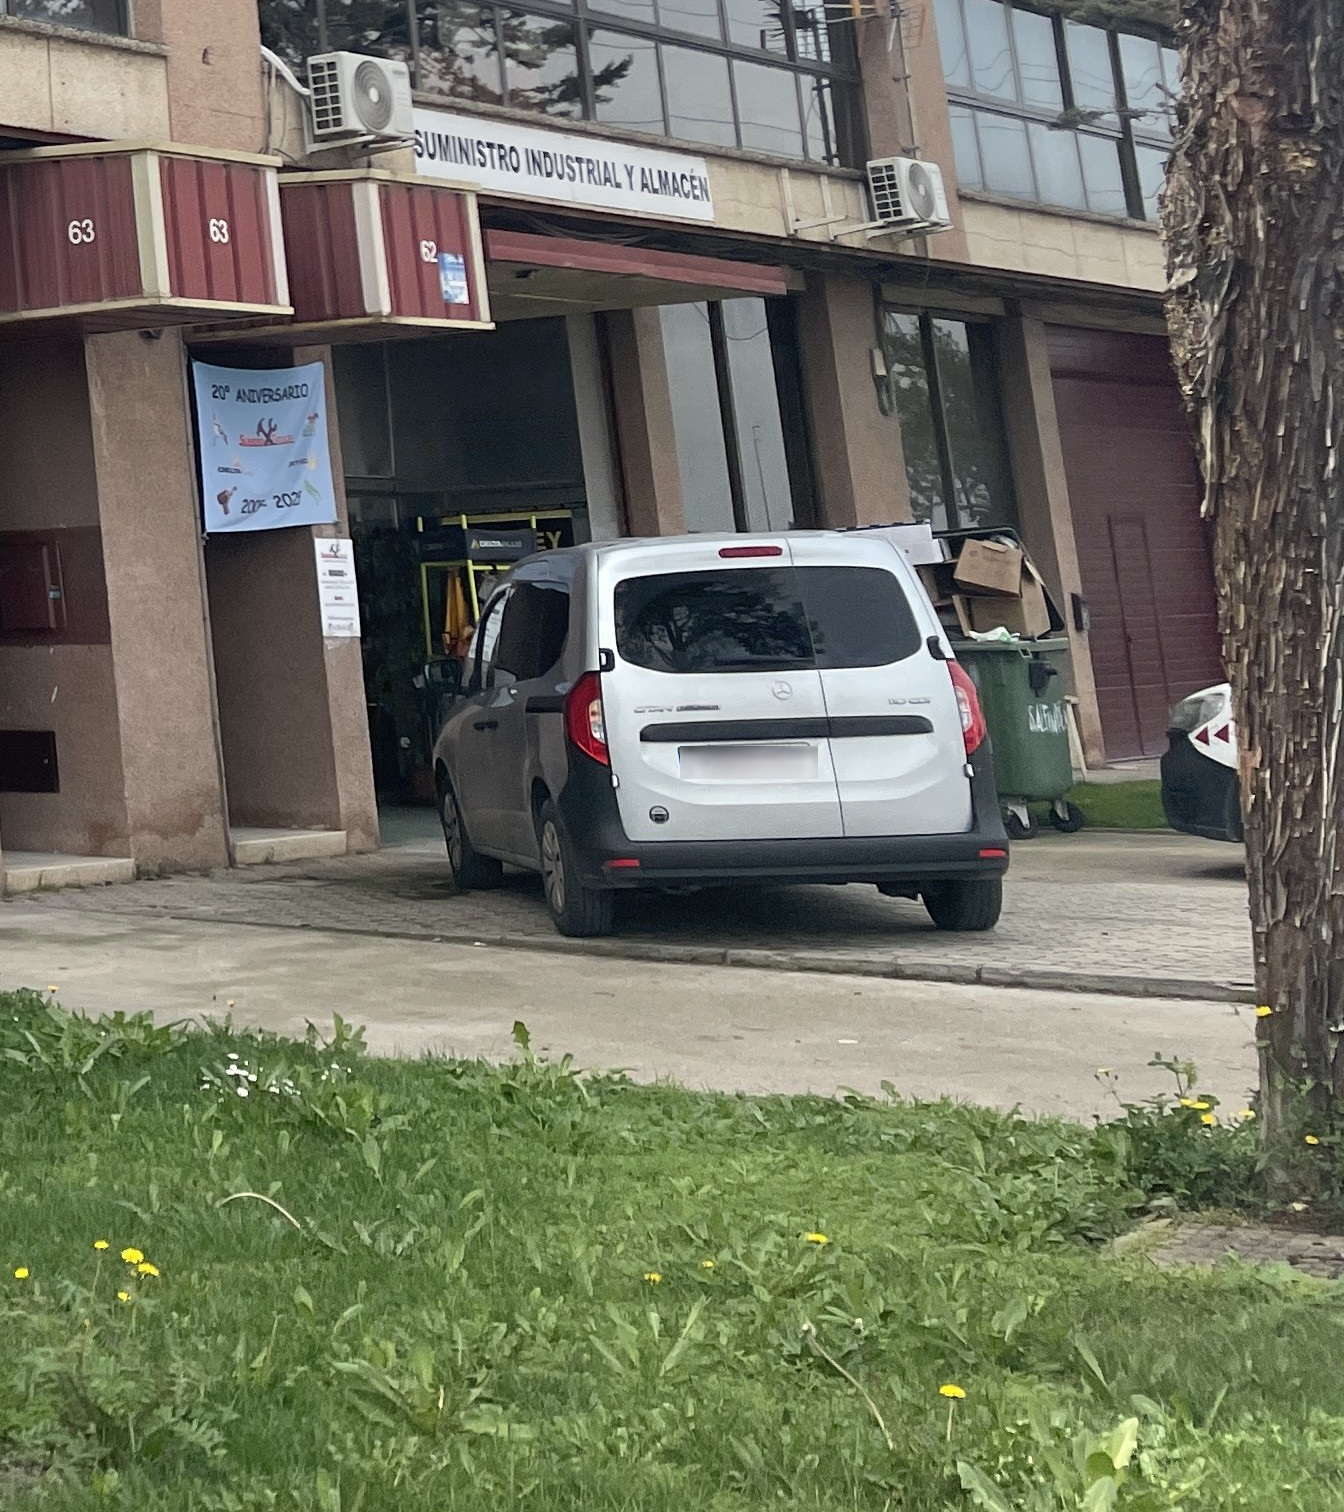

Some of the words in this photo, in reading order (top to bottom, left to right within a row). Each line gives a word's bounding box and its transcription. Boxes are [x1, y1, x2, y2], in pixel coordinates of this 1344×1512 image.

[414, 129, 521, 174] SUMINISTRO
[524, 147, 623, 190] INDUSTRIAL
[625, 164, 635, 191] Y
[640, 168, 711, 203] ALMACÉN
[68, 219, 96, 245] 63
[209, 218, 230, 244] 63
[419, 240, 439, 263] 62
[236, 383, 309, 404] ANIVERSARIO
